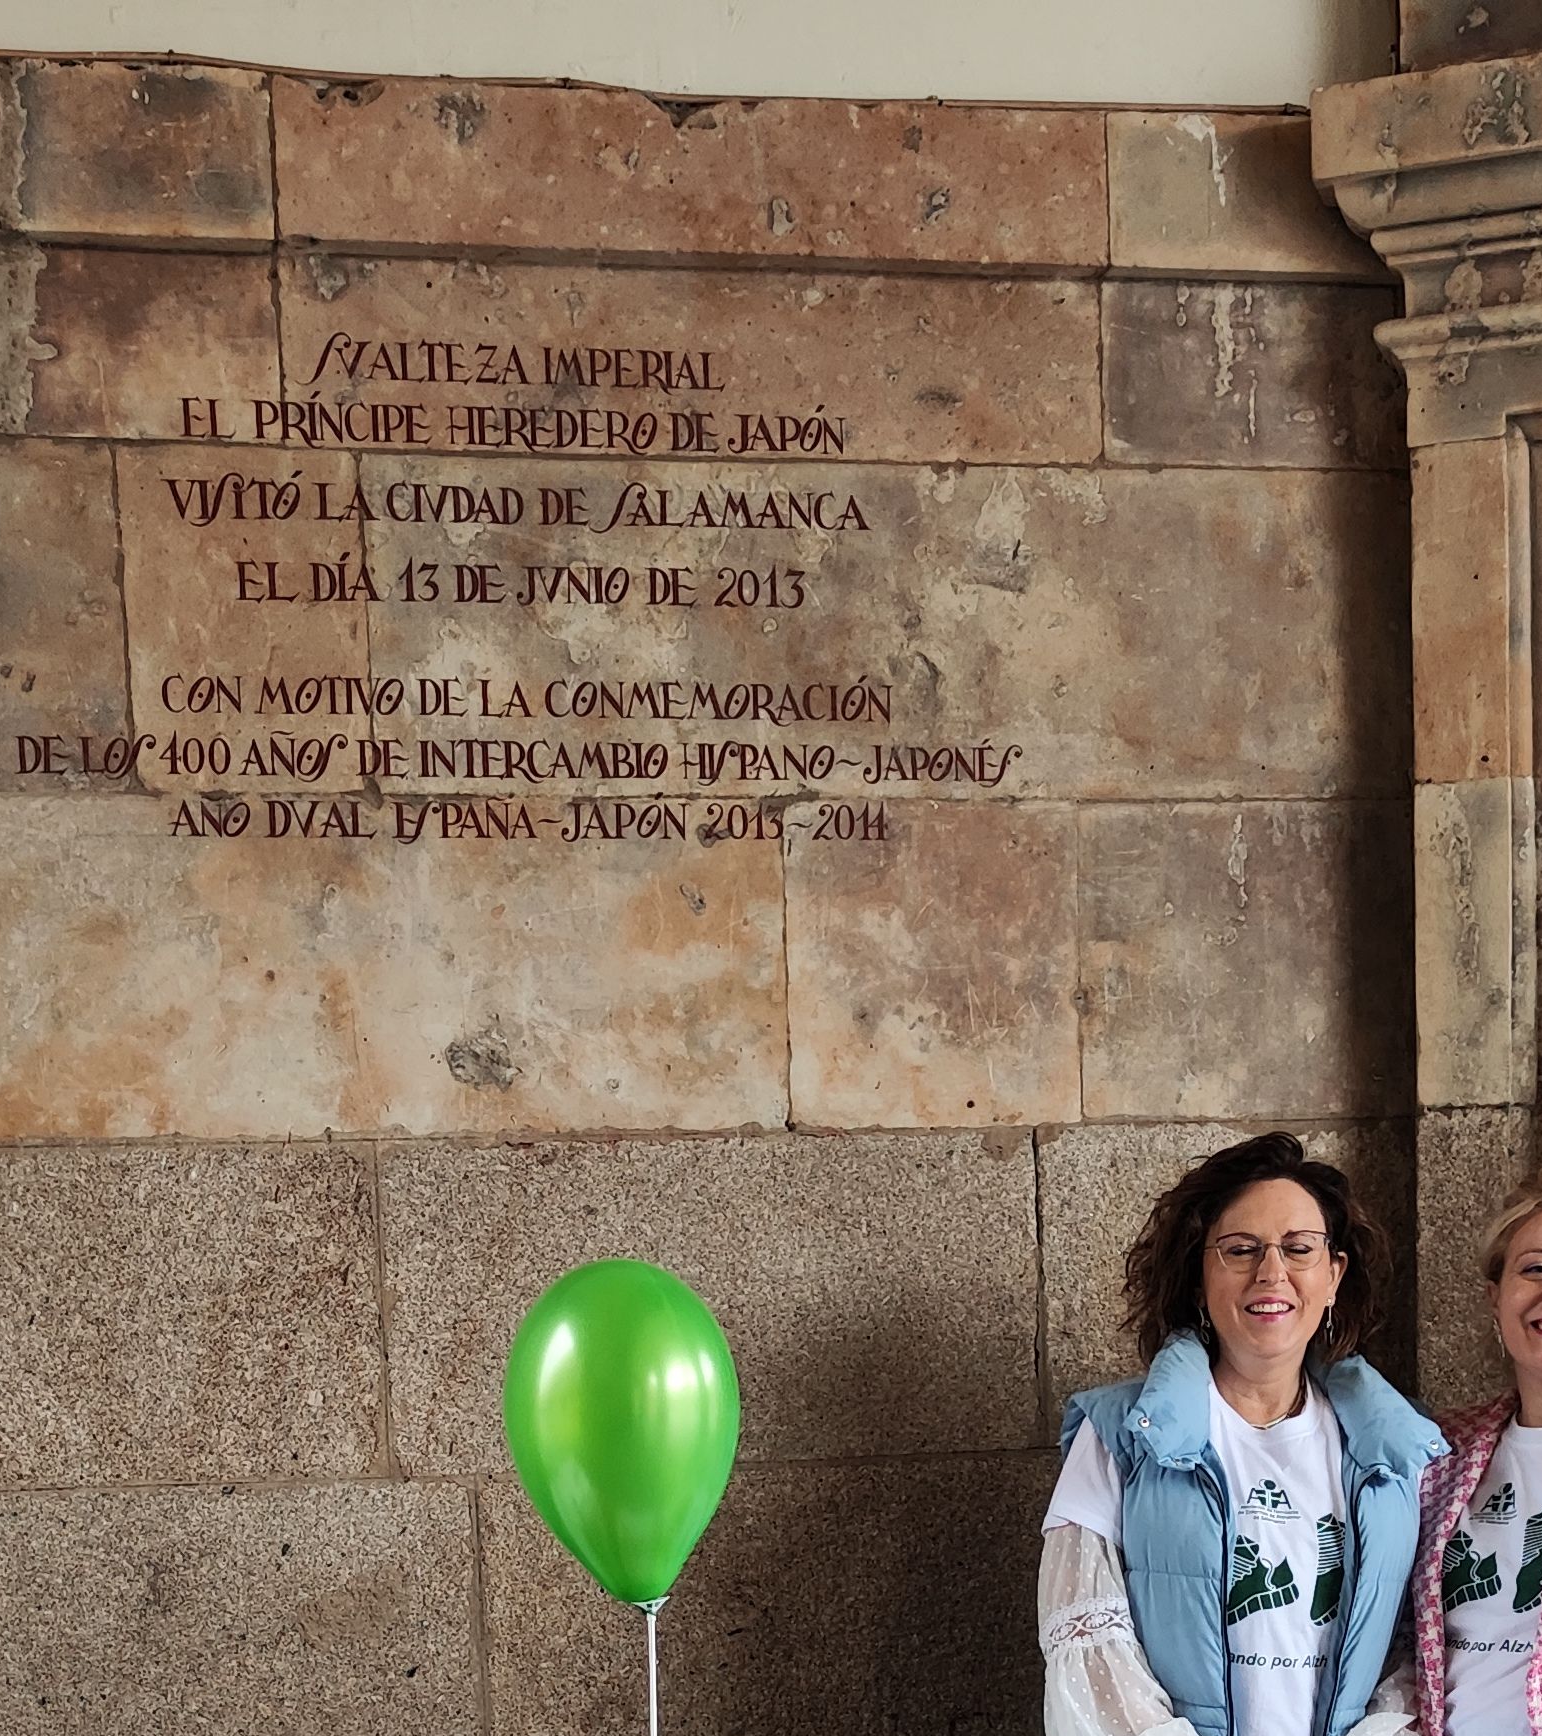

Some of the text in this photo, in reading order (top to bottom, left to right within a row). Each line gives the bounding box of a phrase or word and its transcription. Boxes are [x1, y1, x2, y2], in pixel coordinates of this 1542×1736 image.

[543, 346, 726, 396] IMPERIAL
[178, 390, 846, 455] EL PRÍNCIPE HEREDERO DE JAPÓN
[311, 482, 380, 521] LA
[538, 487, 590, 527] DE
[589, 482, 872, 534] SALAMANCA
[236, 560, 301, 602] EL
[308, 552, 379, 602] DÍA
[398, 556, 439, 602] 13
[454, 563, 506, 604] DE
[645, 566, 698, 607] DE
[715, 567, 806, 609] 2013
[161, 673, 894, 727] CON MOTIVO DE LA CONMEMORACIÓN
[15, 734, 68, 775] DE
[159, 731, 232, 776] 400
[239, 731, 347, 782] AÑOS
[355, 737, 411, 779] DE
[417, 737, 670, 783] INTERCAMBIO
[1271, 1655, 1300, 1669] por
